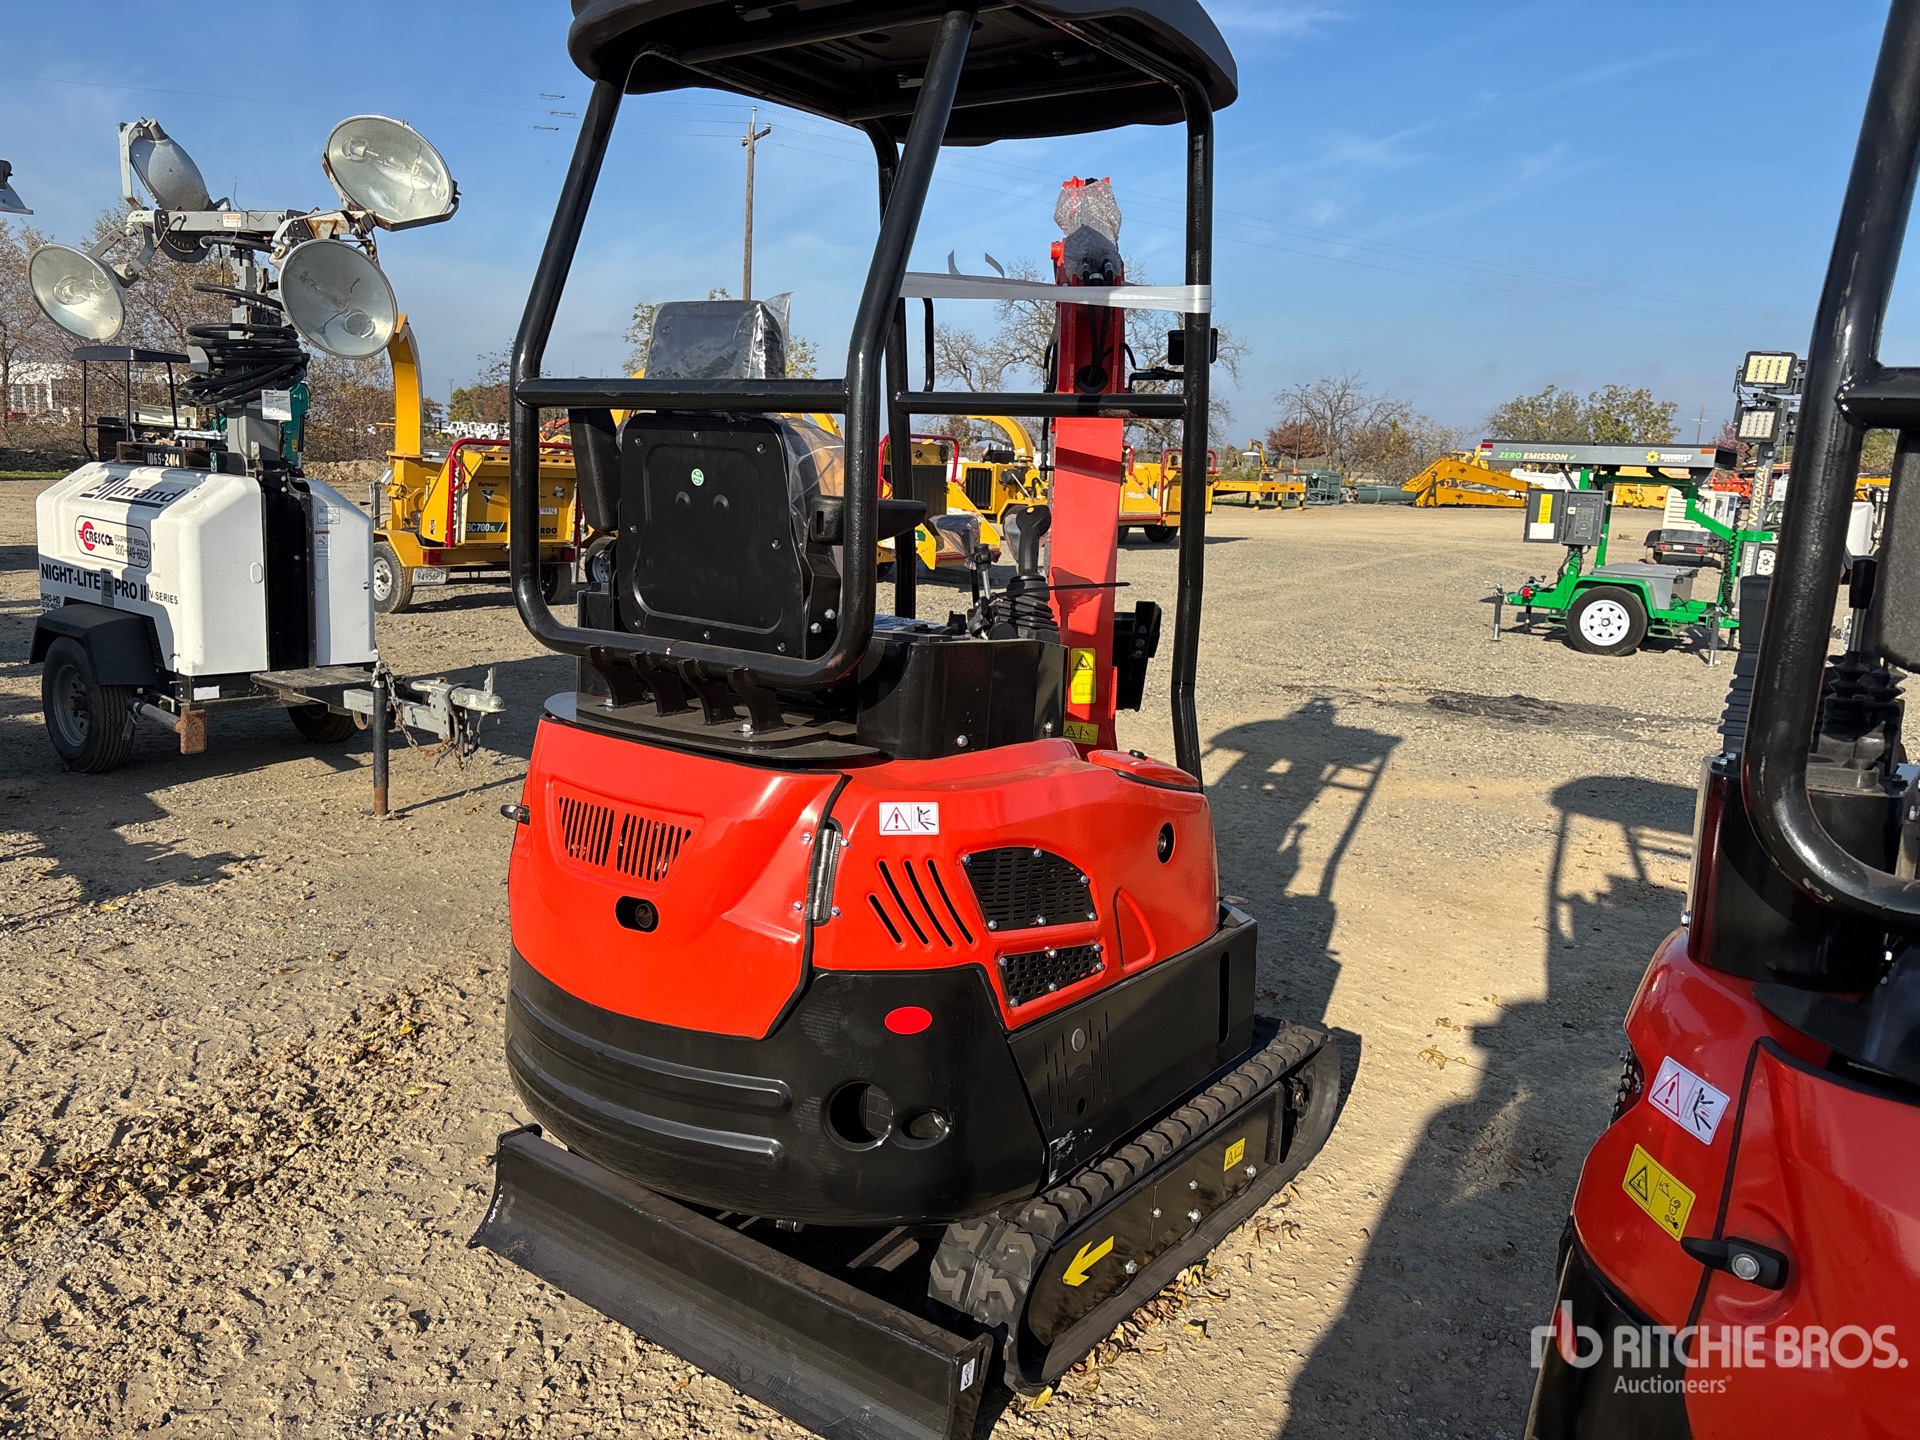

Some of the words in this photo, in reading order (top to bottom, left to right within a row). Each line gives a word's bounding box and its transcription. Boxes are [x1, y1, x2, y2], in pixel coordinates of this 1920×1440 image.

[1499, 451, 1522, 460] ZERO
[1522, 452, 1569, 462] EMISSION
[86, 478, 187, 503] Allmand
[1747, 465, 1768, 527] NATIONAL
[84, 529, 114, 547] CRESCO
[114, 534, 133, 544] EQUIPMENT
[133, 537, 149, 548] RENTALS
[115, 543, 149, 562] 800-649-6629
[41, 562, 101, 591] NIGHT-LITE
[114, 577, 138, 600] PRO
[140, 583, 148, 602] II
[149, 589, 179, 605] V-SERIES
[41, 592, 61, 605] SHO-HD
